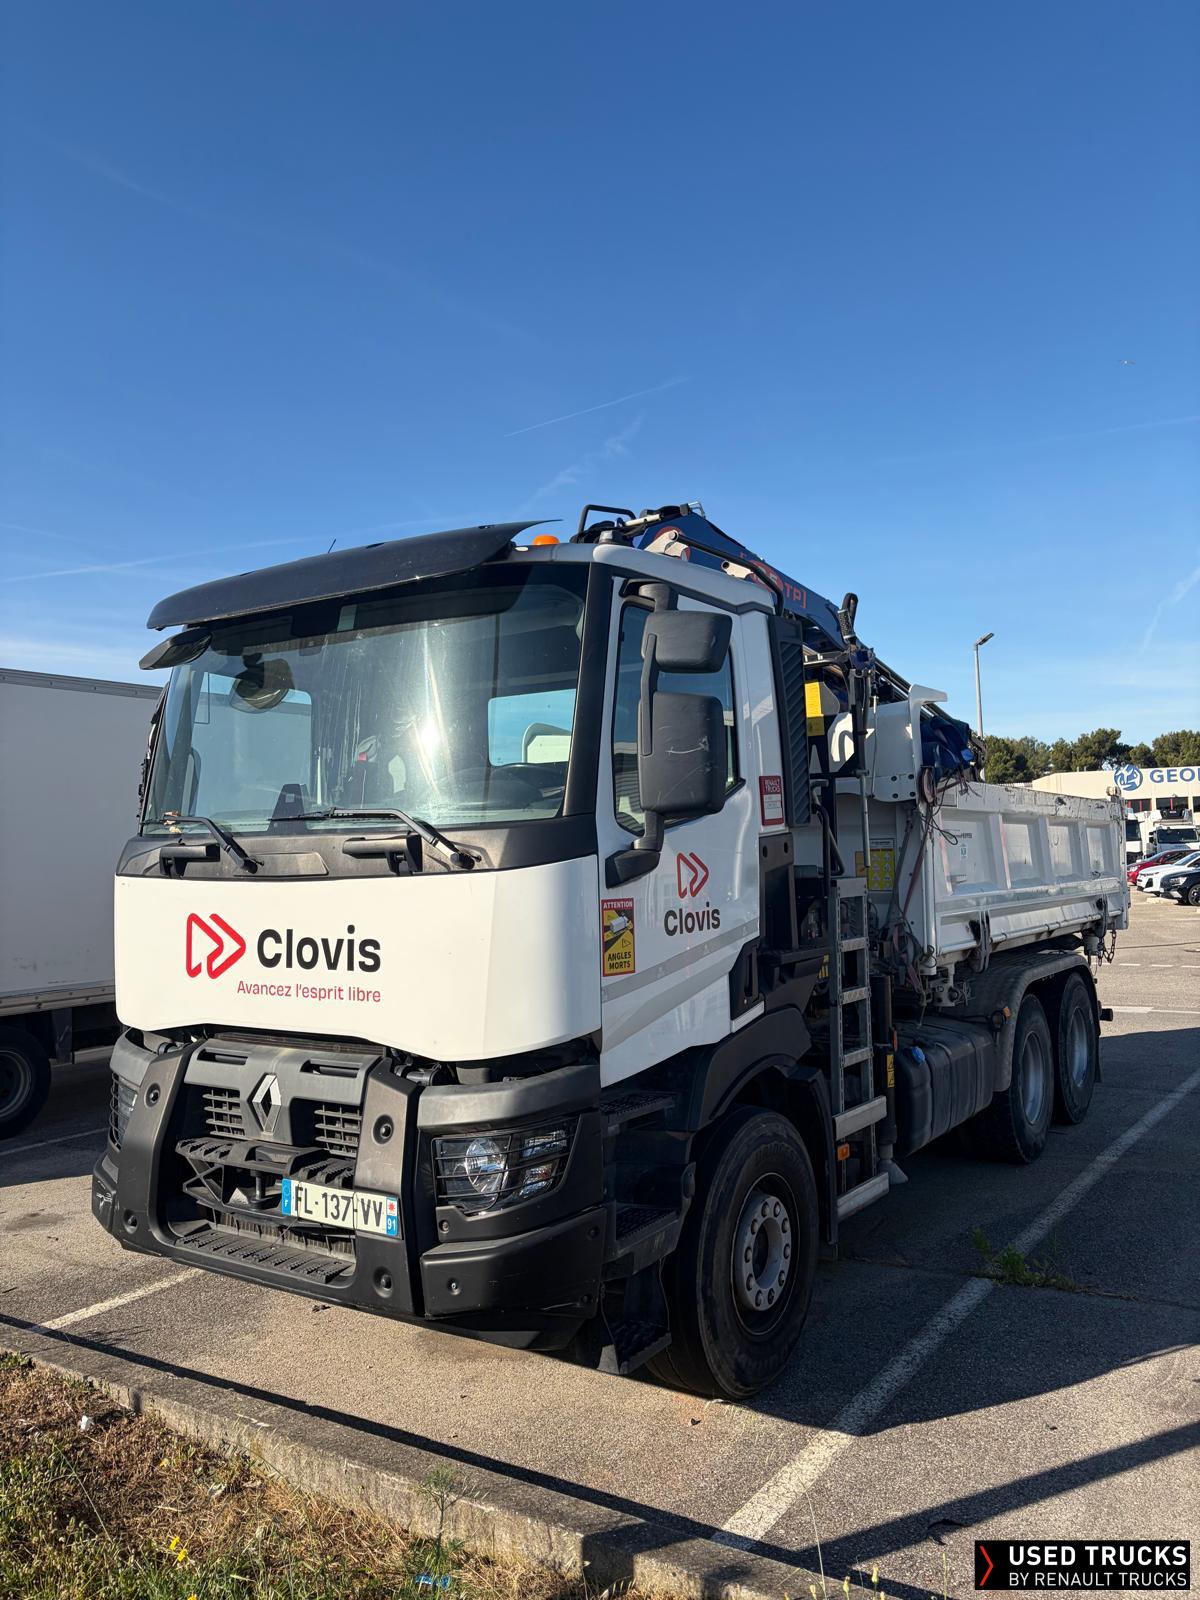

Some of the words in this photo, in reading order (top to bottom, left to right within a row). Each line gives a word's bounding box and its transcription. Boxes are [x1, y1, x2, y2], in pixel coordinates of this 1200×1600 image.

[1150, 768, 1200, 783] GEO
[603, 901, 633, 909] ATTENTION
[664, 902, 721, 936] Clovis
[256, 924, 381, 973] Clovis
[607, 952, 632, 961] ANGLES
[609, 961, 631, 970] MORTS
[237, 981, 292, 997] Avancez
[296, 984, 345, 1001] l'esprit
[348, 987, 382, 1003] libre
[387, 1218, 396, 1231] 91
